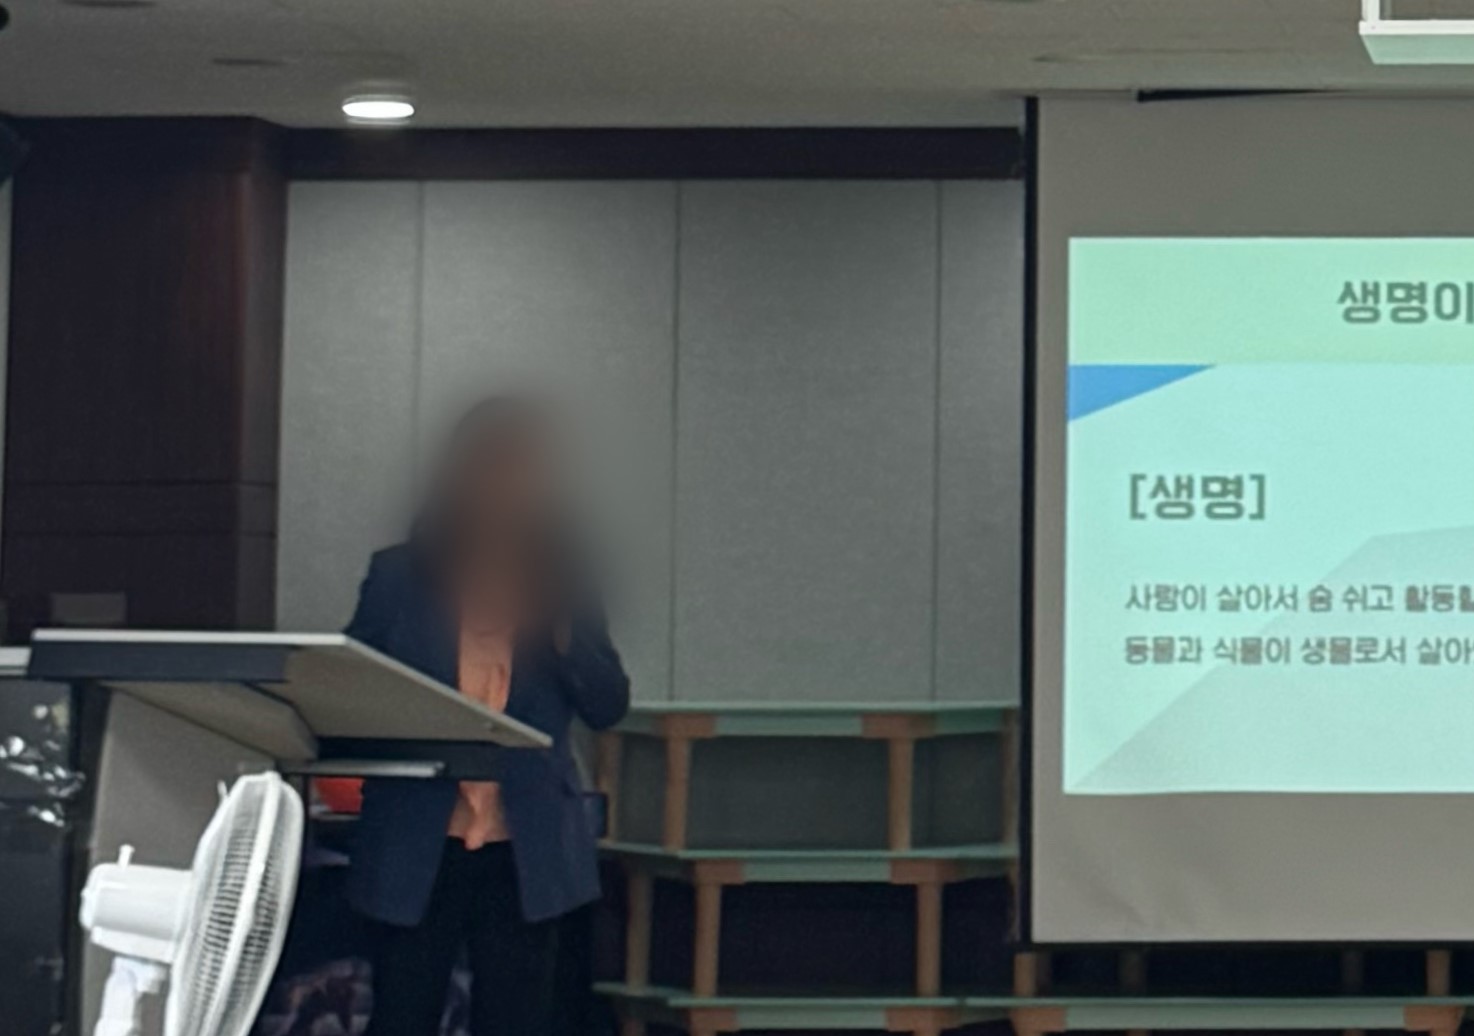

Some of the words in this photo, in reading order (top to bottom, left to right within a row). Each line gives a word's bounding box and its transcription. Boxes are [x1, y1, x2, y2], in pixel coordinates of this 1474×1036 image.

[1129, 474, 1266, 520] [생명]
[1216, 584, 1299, 612] 살아서
[1308, 584, 1333, 612] 숨
[1342, 584, 1394, 612] 쉬고
[1125, 636, 1203, 665] 동물과
[1214, 636, 1291, 665] 식물이
[1301, 636, 1406, 665] 생물로서
